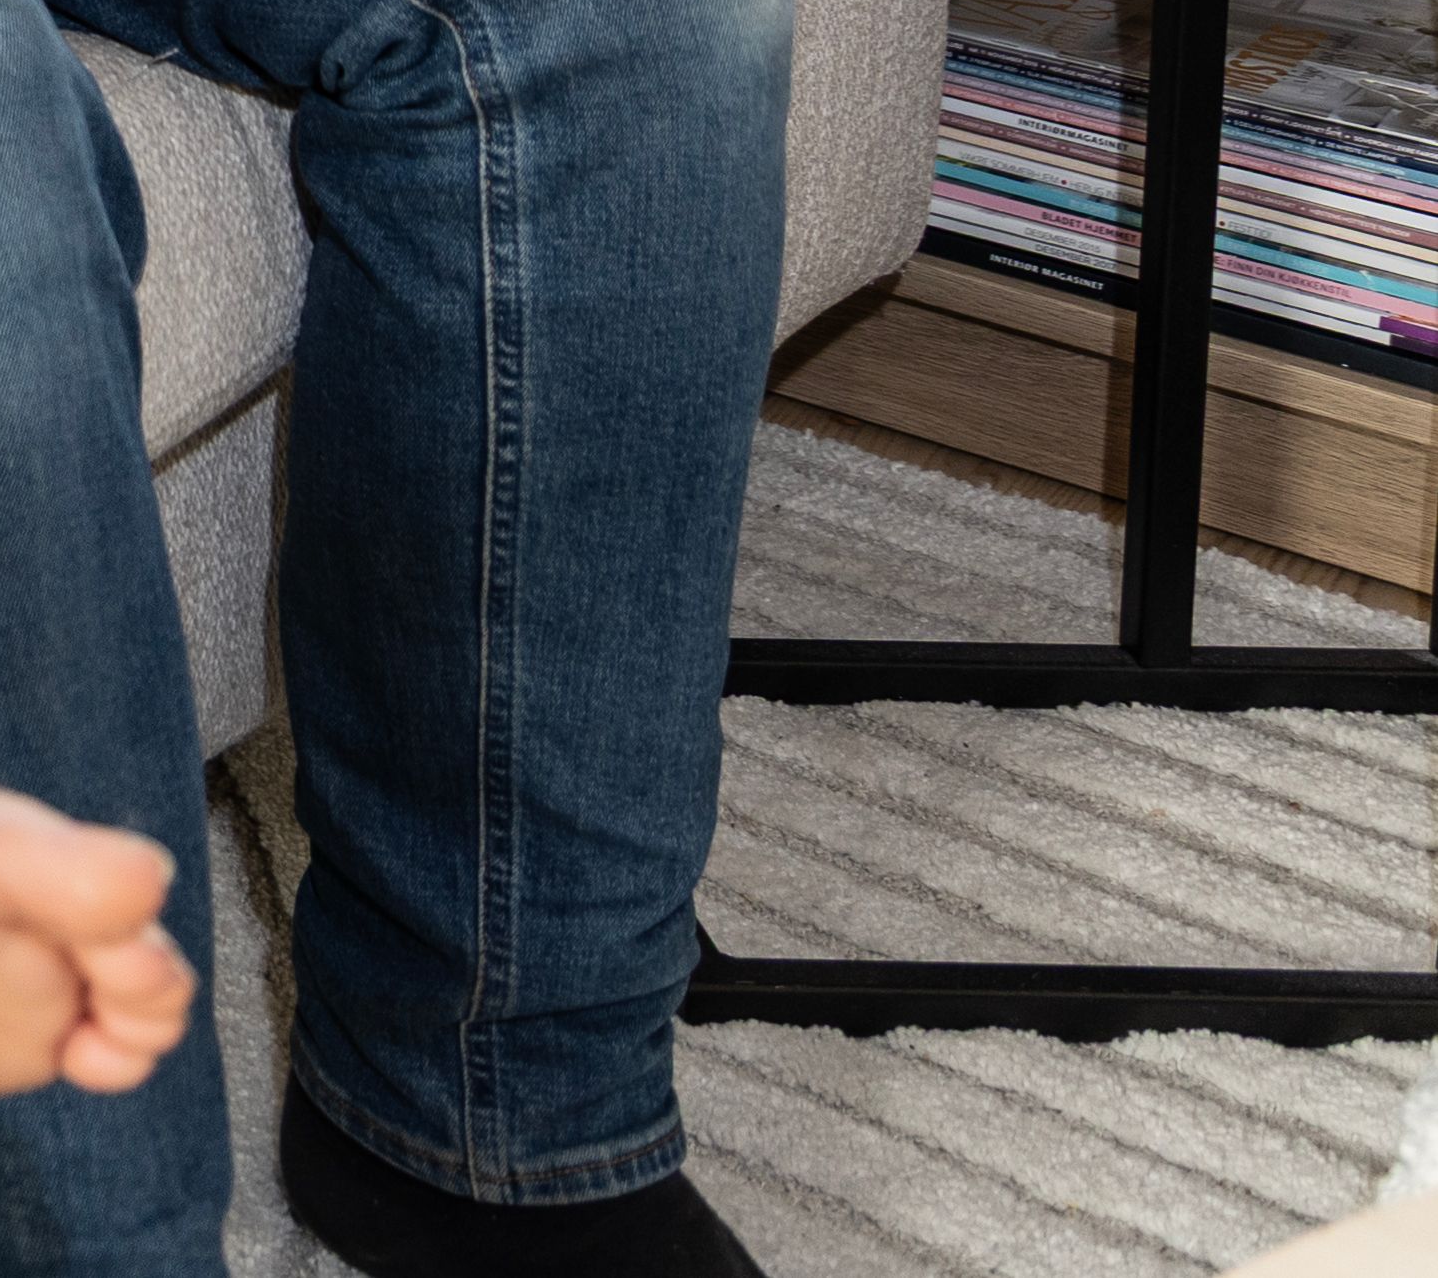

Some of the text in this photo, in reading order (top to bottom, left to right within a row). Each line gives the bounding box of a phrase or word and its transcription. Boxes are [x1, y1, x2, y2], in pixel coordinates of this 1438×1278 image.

[1018, 117, 1129, 152] INTERIØRMAGASINET
[1023, 226, 1077, 246] DESEMBER
[1040, 211, 1138, 242] BLADET HJEMMET
[1035, 243, 1091, 265] DESEMBER
[1041, 267, 1105, 291] MAGASINET
[1226, 258, 1255, 274] FINN
[1255, 265, 1278, 280] DIN
[1277, 271, 1353, 300] KJØKKENSTIL
